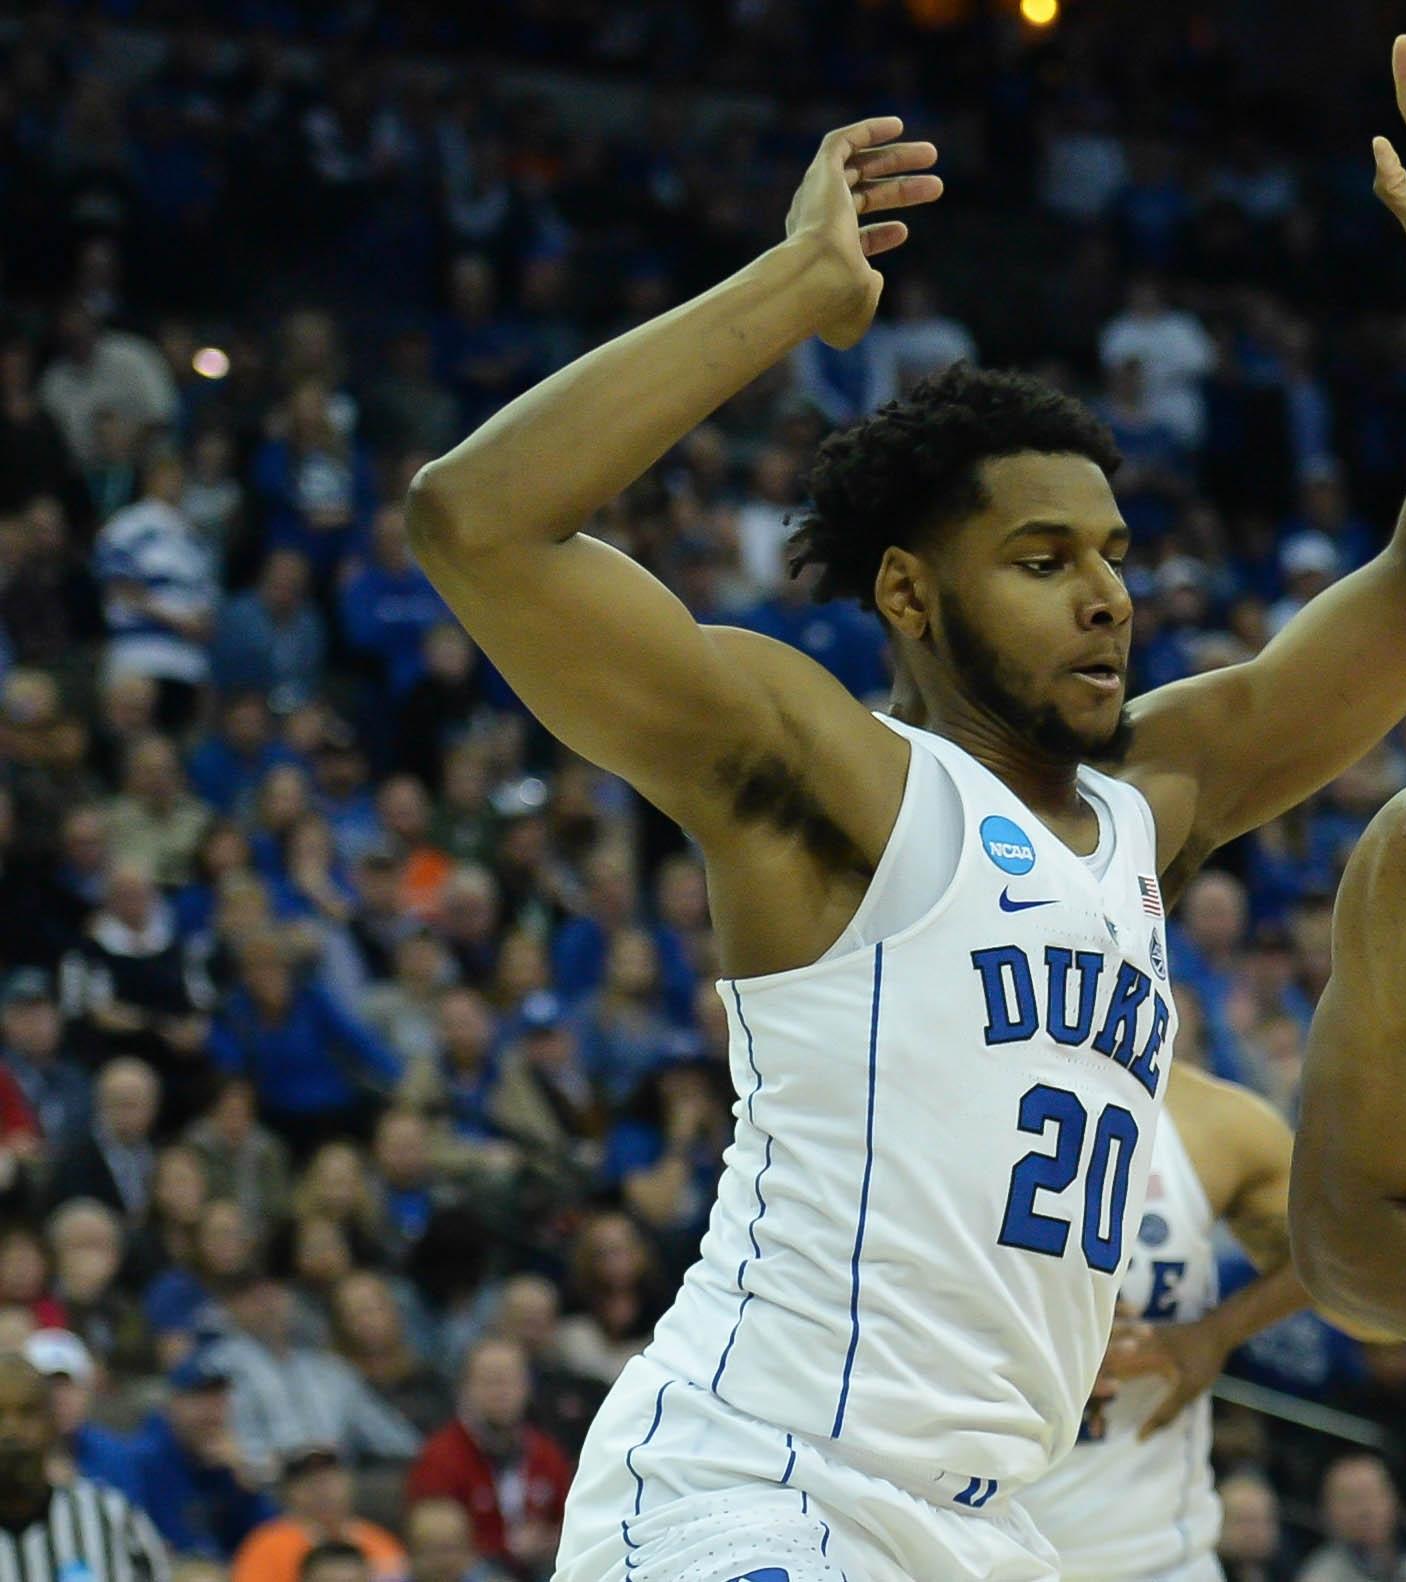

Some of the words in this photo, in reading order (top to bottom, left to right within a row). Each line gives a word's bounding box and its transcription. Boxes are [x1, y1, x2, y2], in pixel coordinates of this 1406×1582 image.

[989, 840, 1034, 862] NCAA
[970, 944, 1170, 1099] DUKE
[997, 1082, 1140, 1275] 20
